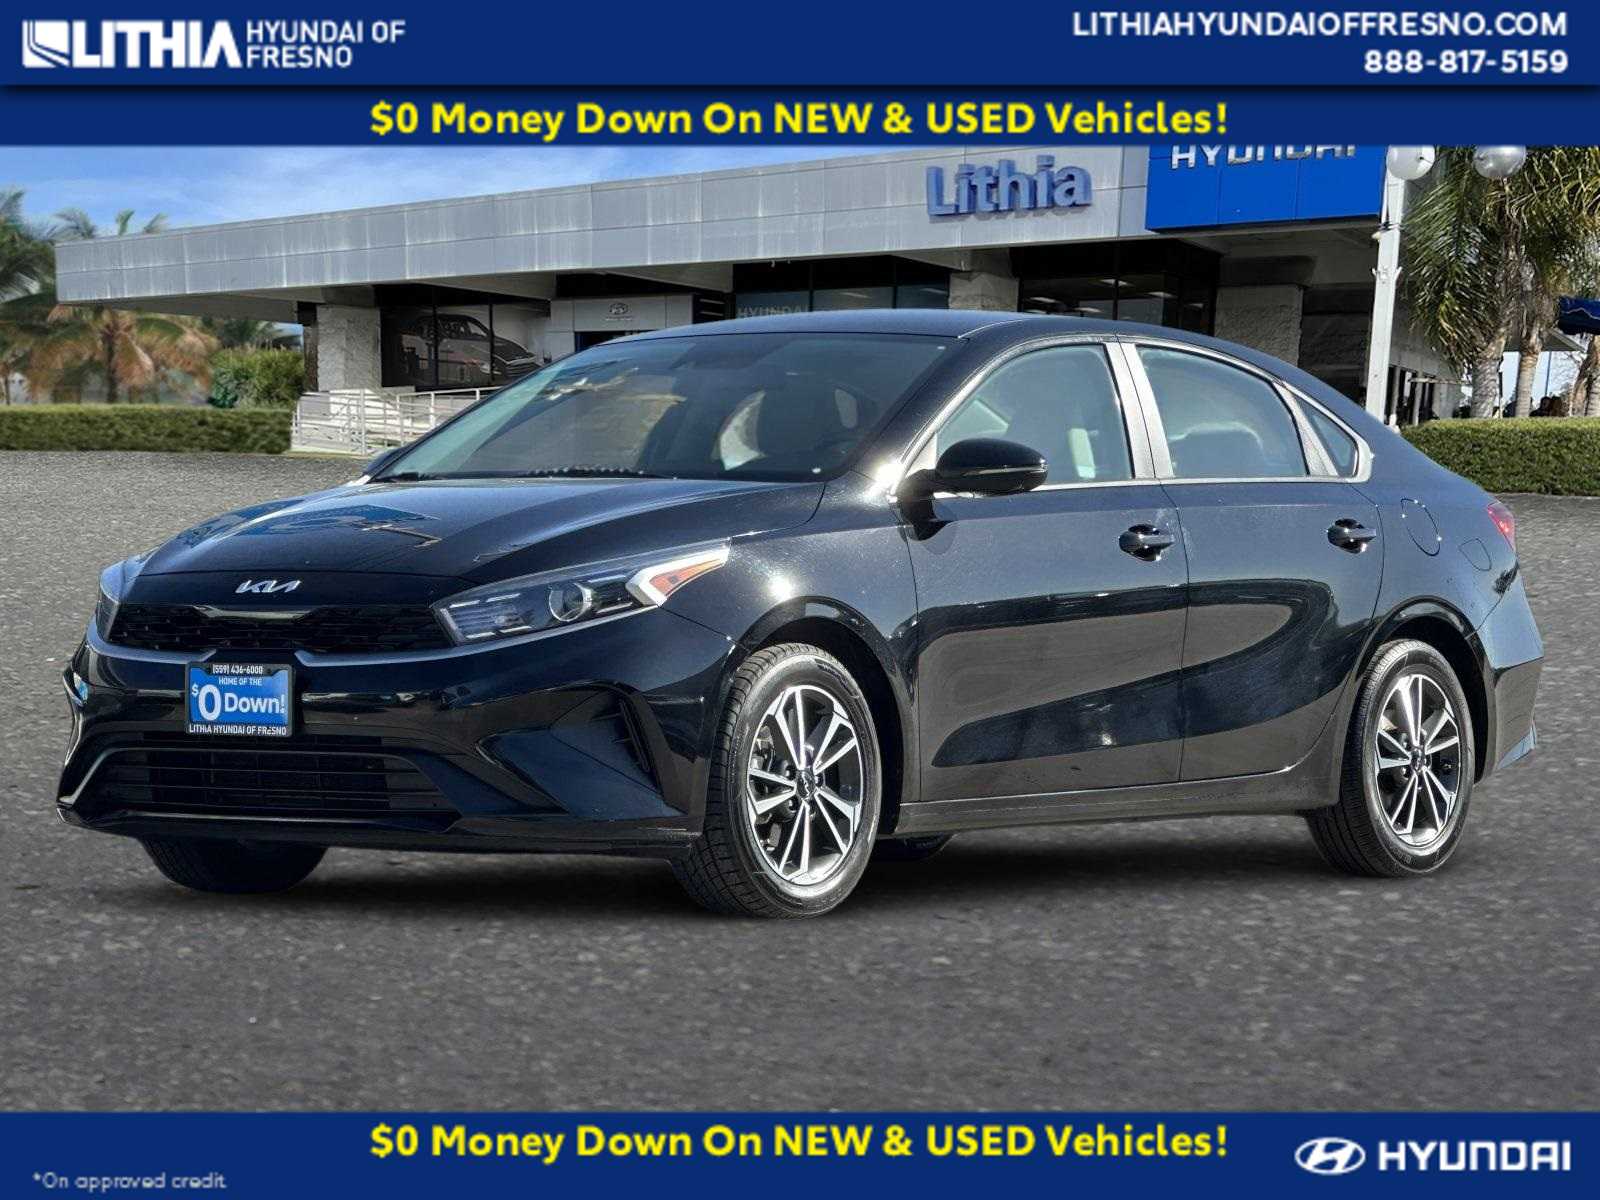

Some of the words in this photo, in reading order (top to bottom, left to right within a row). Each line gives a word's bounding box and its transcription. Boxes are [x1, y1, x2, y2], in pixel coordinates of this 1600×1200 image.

[926, 155, 1092, 216] Lithia
[212, 664, 229, 674] (559)
[230, 664, 263, 674] 436-6000
[219, 677, 237, 686] HOME
[238, 677, 247, 685] OF
[249, 677, 263, 687] THE
[224, 692, 285, 714] Down!
[189, 724, 212, 733] LITHIA
[213, 725, 244, 734] HYUNDAI
[246, 726, 256, 734] OF
[257, 726, 287, 735] FRESNO
